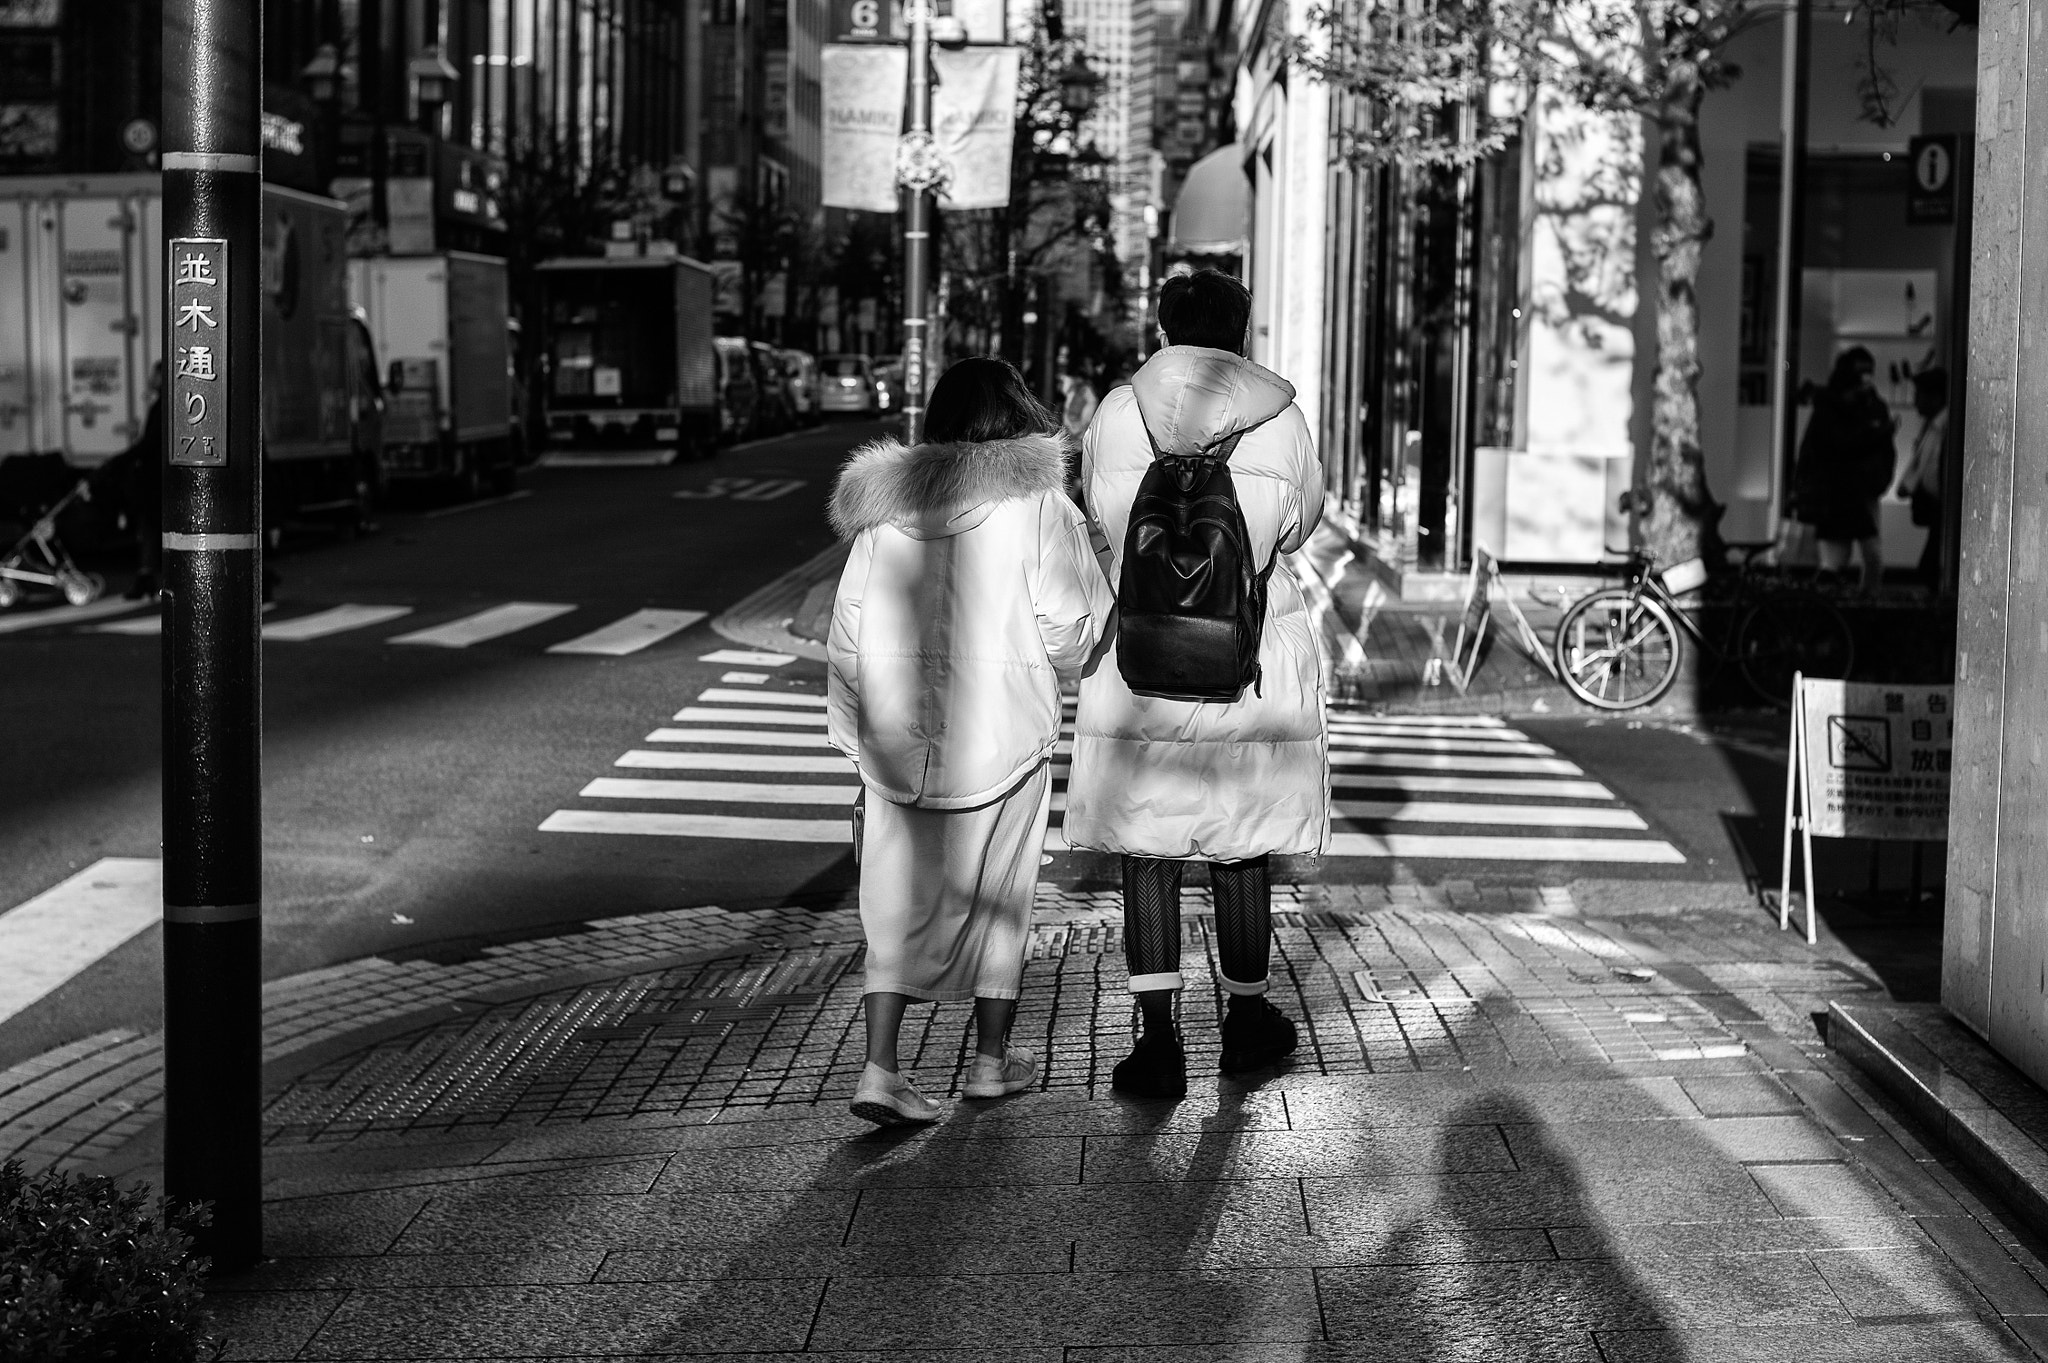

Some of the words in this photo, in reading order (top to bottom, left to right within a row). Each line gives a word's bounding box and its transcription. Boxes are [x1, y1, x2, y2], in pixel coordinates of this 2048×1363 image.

[851, 0, 879, 27] 6
[175, 252, 217, 425] 並木通り
